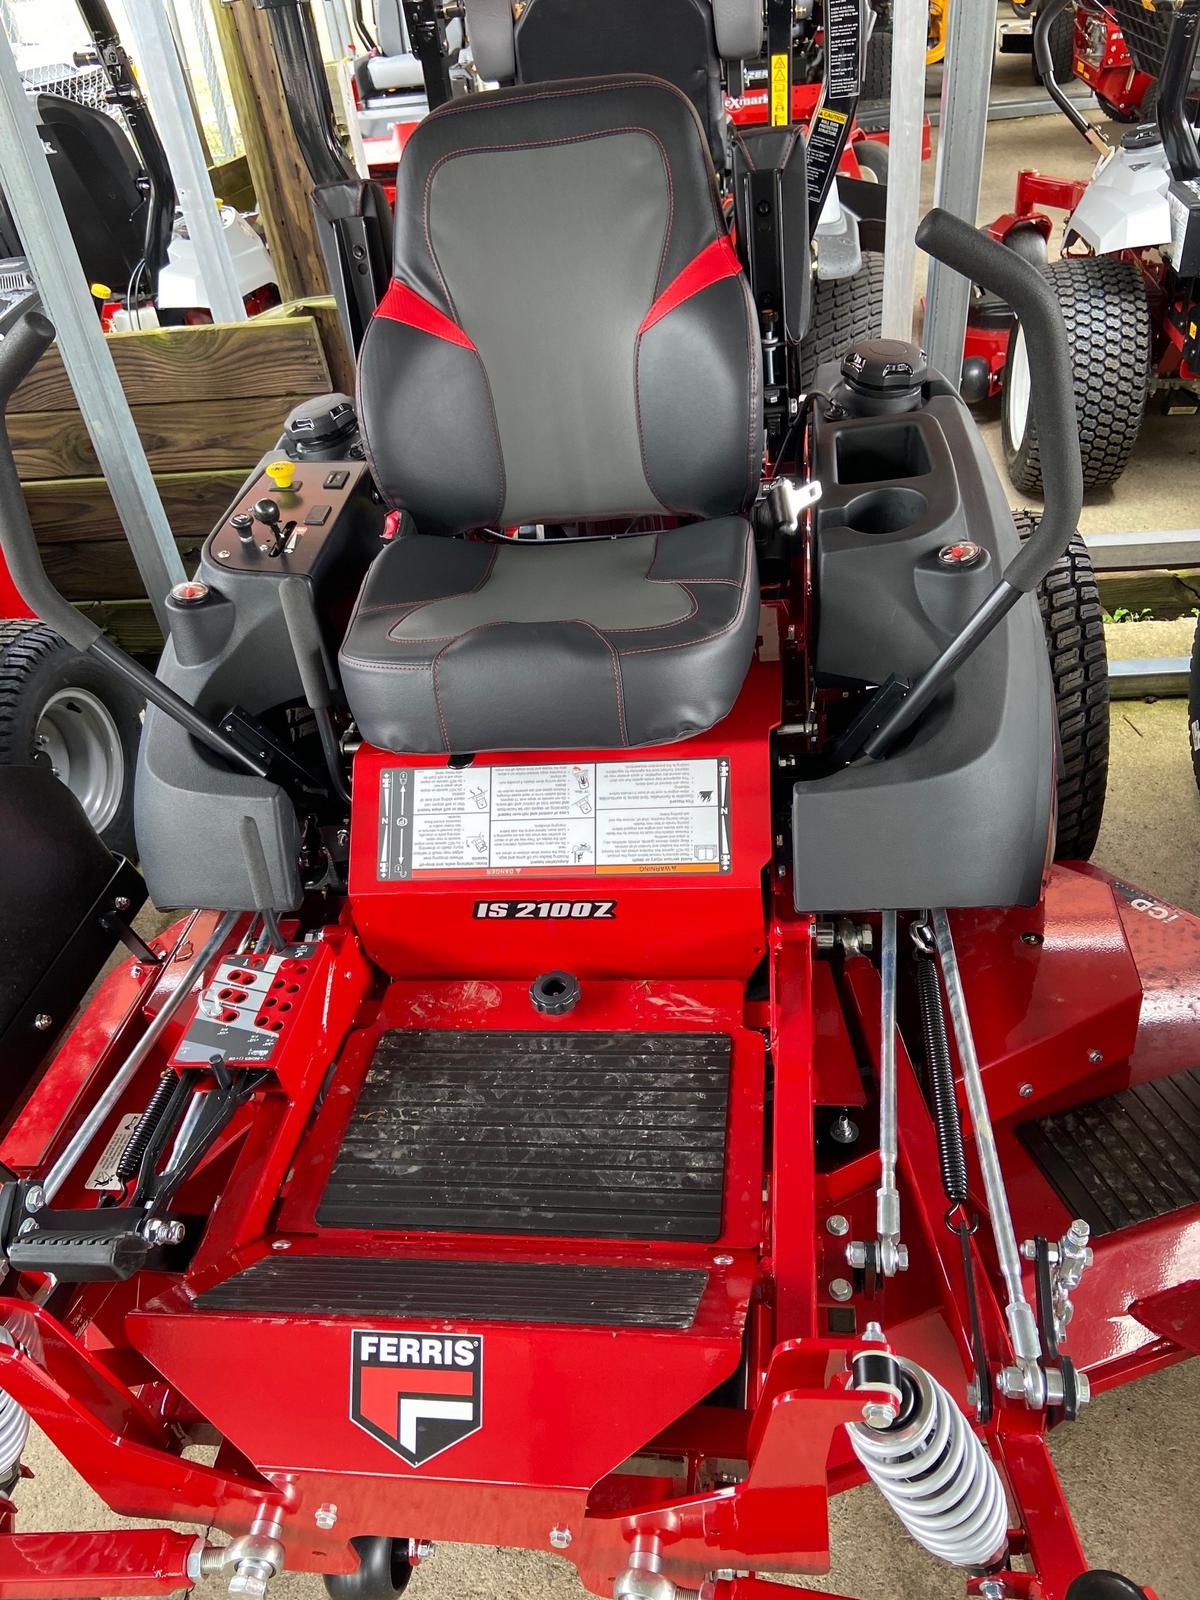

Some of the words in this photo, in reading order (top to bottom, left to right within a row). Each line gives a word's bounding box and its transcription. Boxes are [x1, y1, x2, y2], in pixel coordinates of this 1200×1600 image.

[823, 112, 845, 122] CAUTION
[476, 902, 508, 918] IS
[515, 902, 615, 918] 2100Z
[360, 1336, 475, 1366] FERRIS
